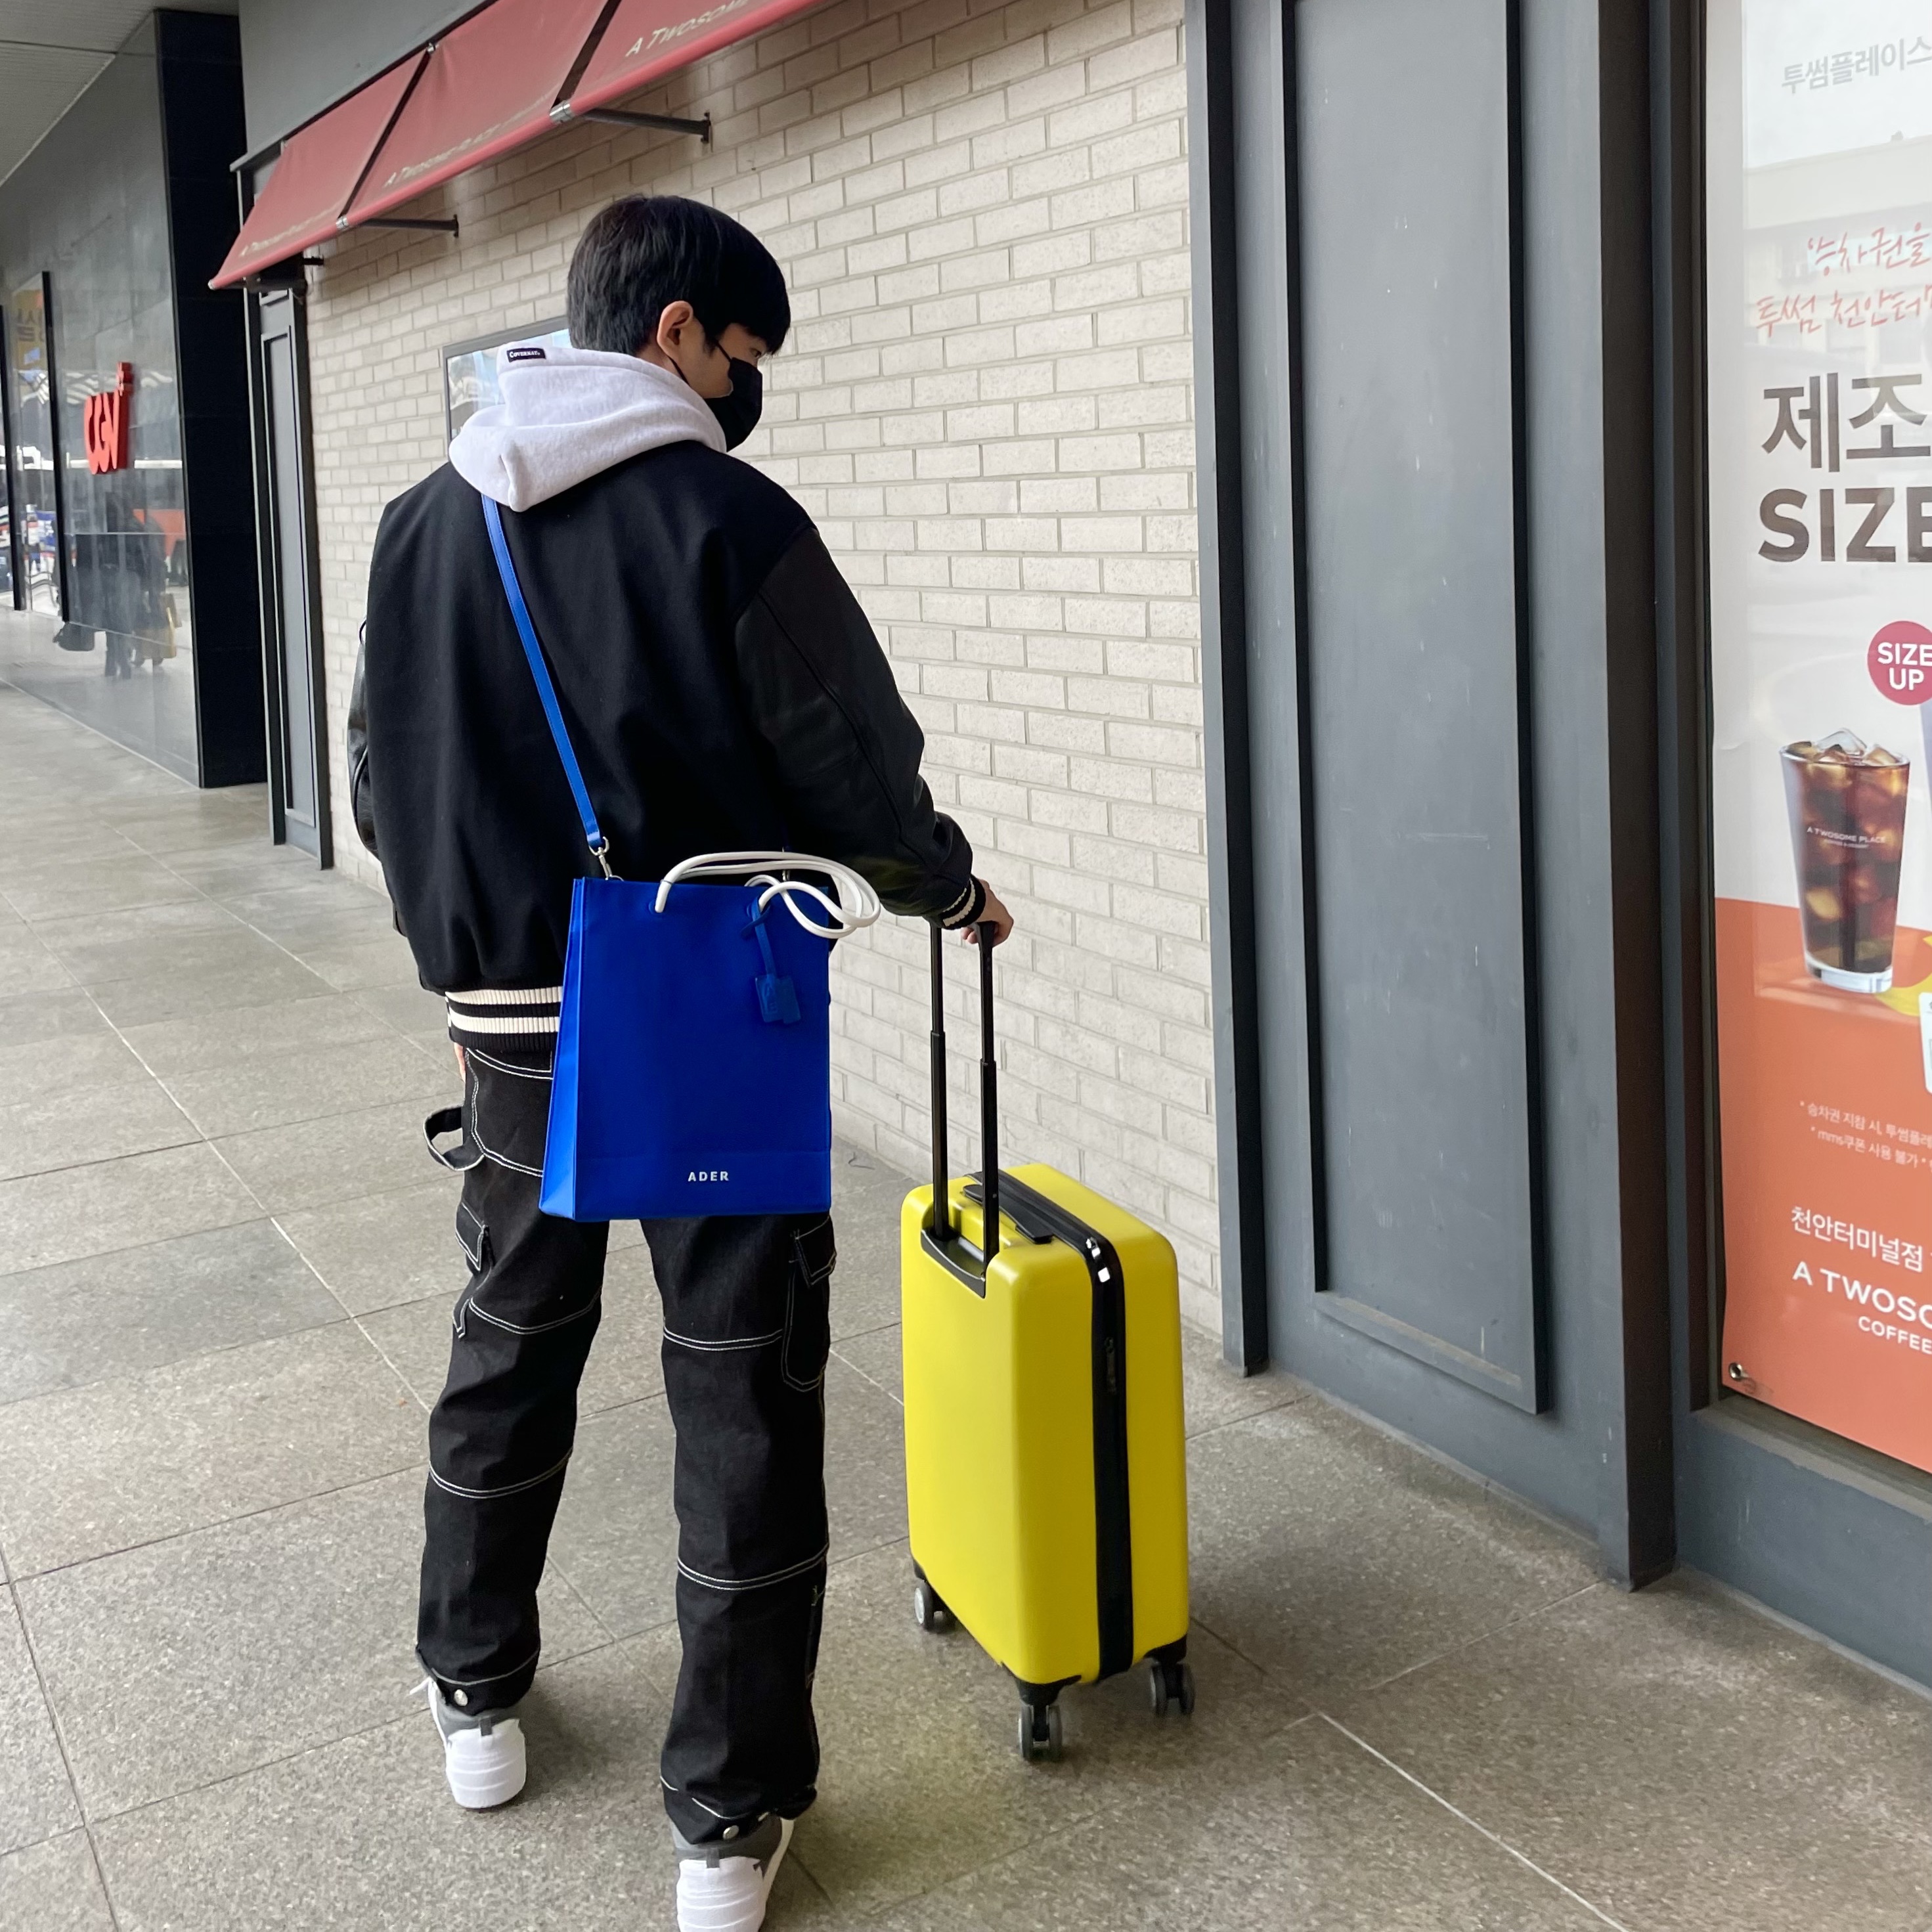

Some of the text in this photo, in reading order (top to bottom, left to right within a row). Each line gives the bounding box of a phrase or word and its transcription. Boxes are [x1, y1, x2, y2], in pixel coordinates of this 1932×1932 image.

[625, 37, 644, 56] A
[1781, 35, 1932, 94] 투썸플레이스
[1756, 295, 1822, 338] 투썸
[1761, 372, 1931, 472] 제조
[1758, 487, 1932, 563] SIZE
[1877, 642, 1932, 667] SIZE
[1889, 667, 1924, 691] UP
[1807, 1103, 1840, 1123] 승차권
[688, 1171, 729, 1182] ADER
[1791, 1206, 1922, 1273] 천안터미널점
[1792, 1261, 1813, 1286] A
[1858, 1316, 1932, 1355] COFFEE
